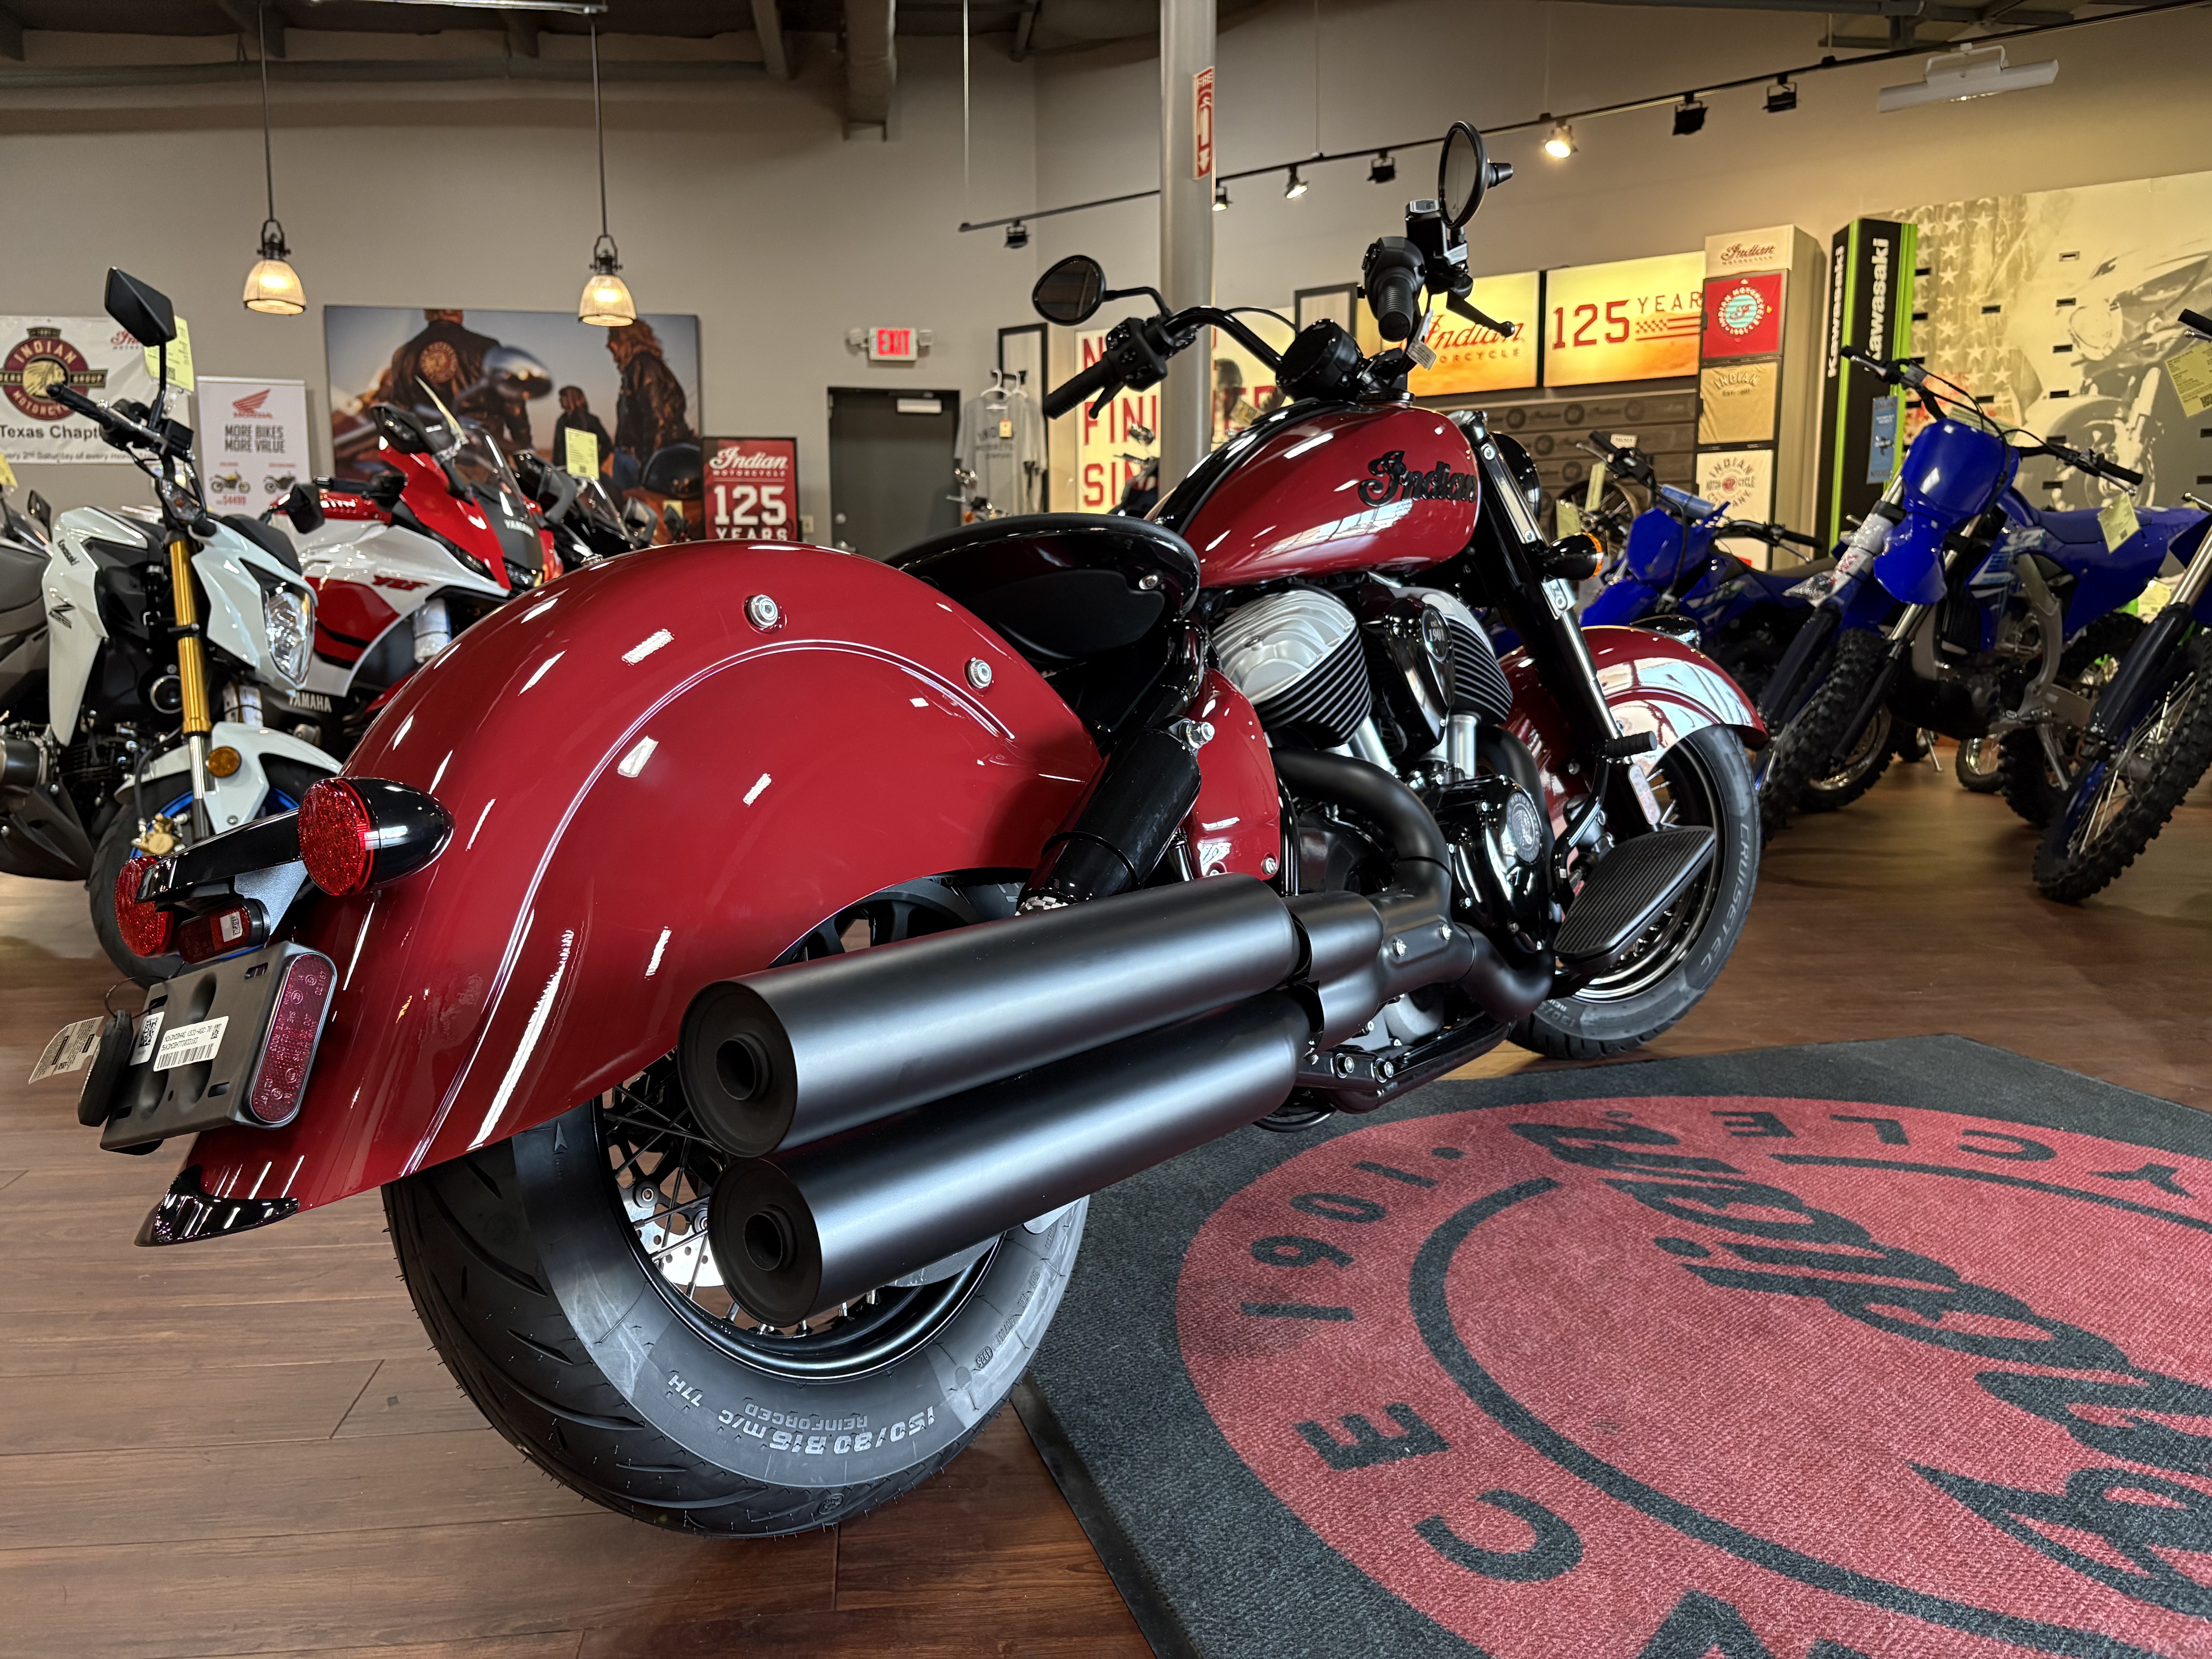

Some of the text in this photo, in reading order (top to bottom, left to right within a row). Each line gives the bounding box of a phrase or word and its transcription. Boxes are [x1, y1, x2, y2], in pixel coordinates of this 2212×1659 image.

[1721, 243, 1776, 261] Indian
[1827, 246, 1844, 378] Kawasaki
[1865, 238, 1889, 371] Kawasaki
[1552, 292, 1702, 350] 125 YEAR
[14, 340, 77, 364] INDIAN
[877, 328, 911, 356] EXIT
[1439, 348, 1521, 364] ORCYCLE
[1714, 371, 1760, 390] INDIAN
[12, 388, 70, 416] MOTORCY
[0, 425, 100, 441] Texas Chapt
[225, 424, 284, 439] MORE BIKES
[225, 439, 285, 453] MORE VALUE
[709, 446, 788, 470] Indian
[713, 469, 786, 477] MOTORCYCLE
[1358, 450, 1478, 508] Indian
[1709, 456, 1754, 478] INDIAN
[714, 485, 787, 526] 125
[715, 527, 788, 541] YEARS
[1428, 628, 1445, 642] 1901
[1700, 823, 1749, 974] CRUISETEC
[1240, 1157, 1437, 1323] 1901
[667, 1374, 702, 1407] 77H
[745, 1403, 867, 1431] REINFORCED
[833, 1406, 935, 1454] 150/80
[769, 1431, 827, 1455] B16
